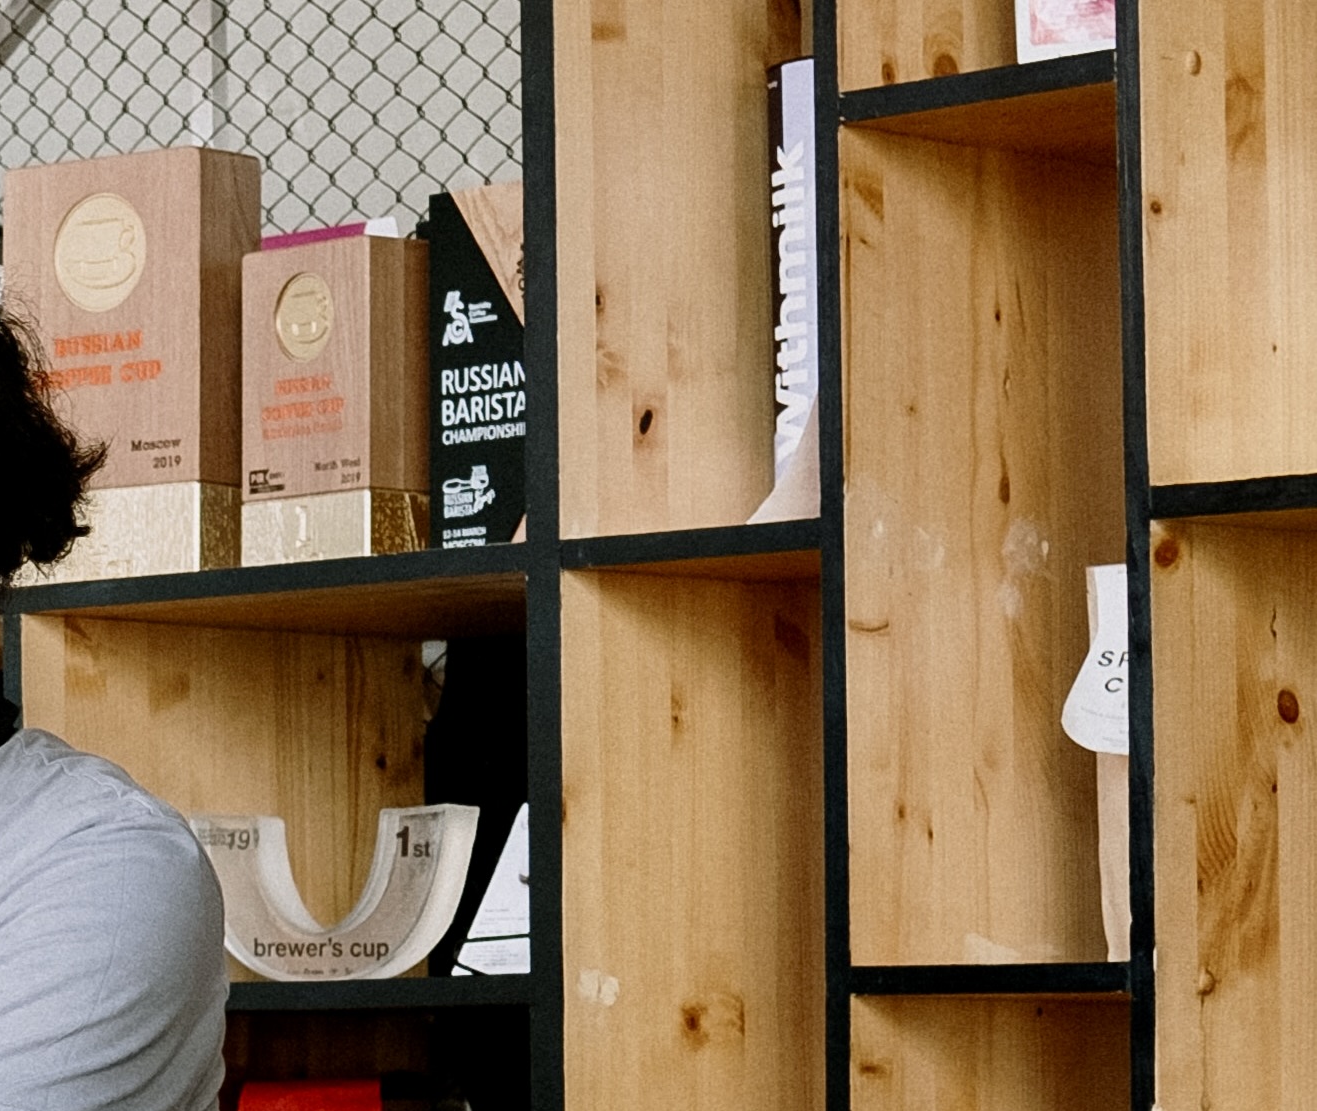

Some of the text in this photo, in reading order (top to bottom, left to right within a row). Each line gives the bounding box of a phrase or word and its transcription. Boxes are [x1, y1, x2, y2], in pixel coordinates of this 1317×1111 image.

[54, 330, 143, 358] RUSSIAN
[120, 360, 162, 383] CUP
[441, 360, 526, 396] RUSSIAN
[441, 391, 526, 427] BARISTA
[131, 439, 182, 452] Moscow
[153, 455, 182, 469] 2019
[396, 825, 431, 857] 1st
[253, 937, 390, 961] brewer's cup
